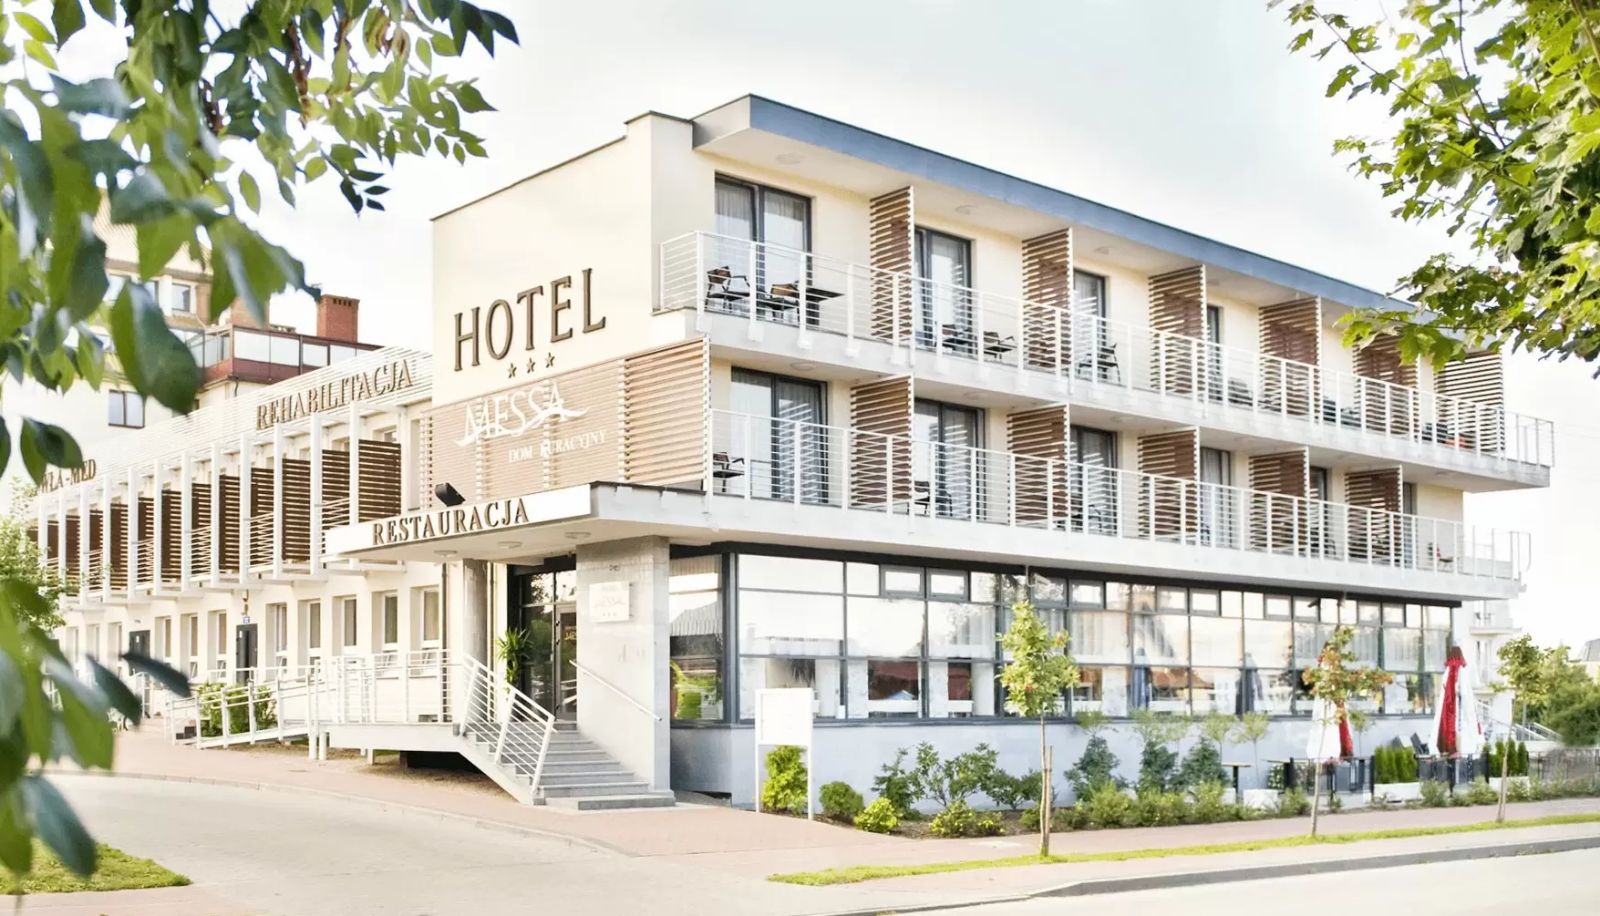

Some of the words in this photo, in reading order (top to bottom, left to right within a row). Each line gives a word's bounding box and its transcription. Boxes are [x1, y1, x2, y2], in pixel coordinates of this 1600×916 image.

[454, 268, 606, 371] HOTEL
[256, 359, 414, 430] REHABILITACJA
[458, 380, 584, 445] MESSA
[508, 446, 533, 463] DOM
[373, 498, 529, 545] RESTAURACJA
